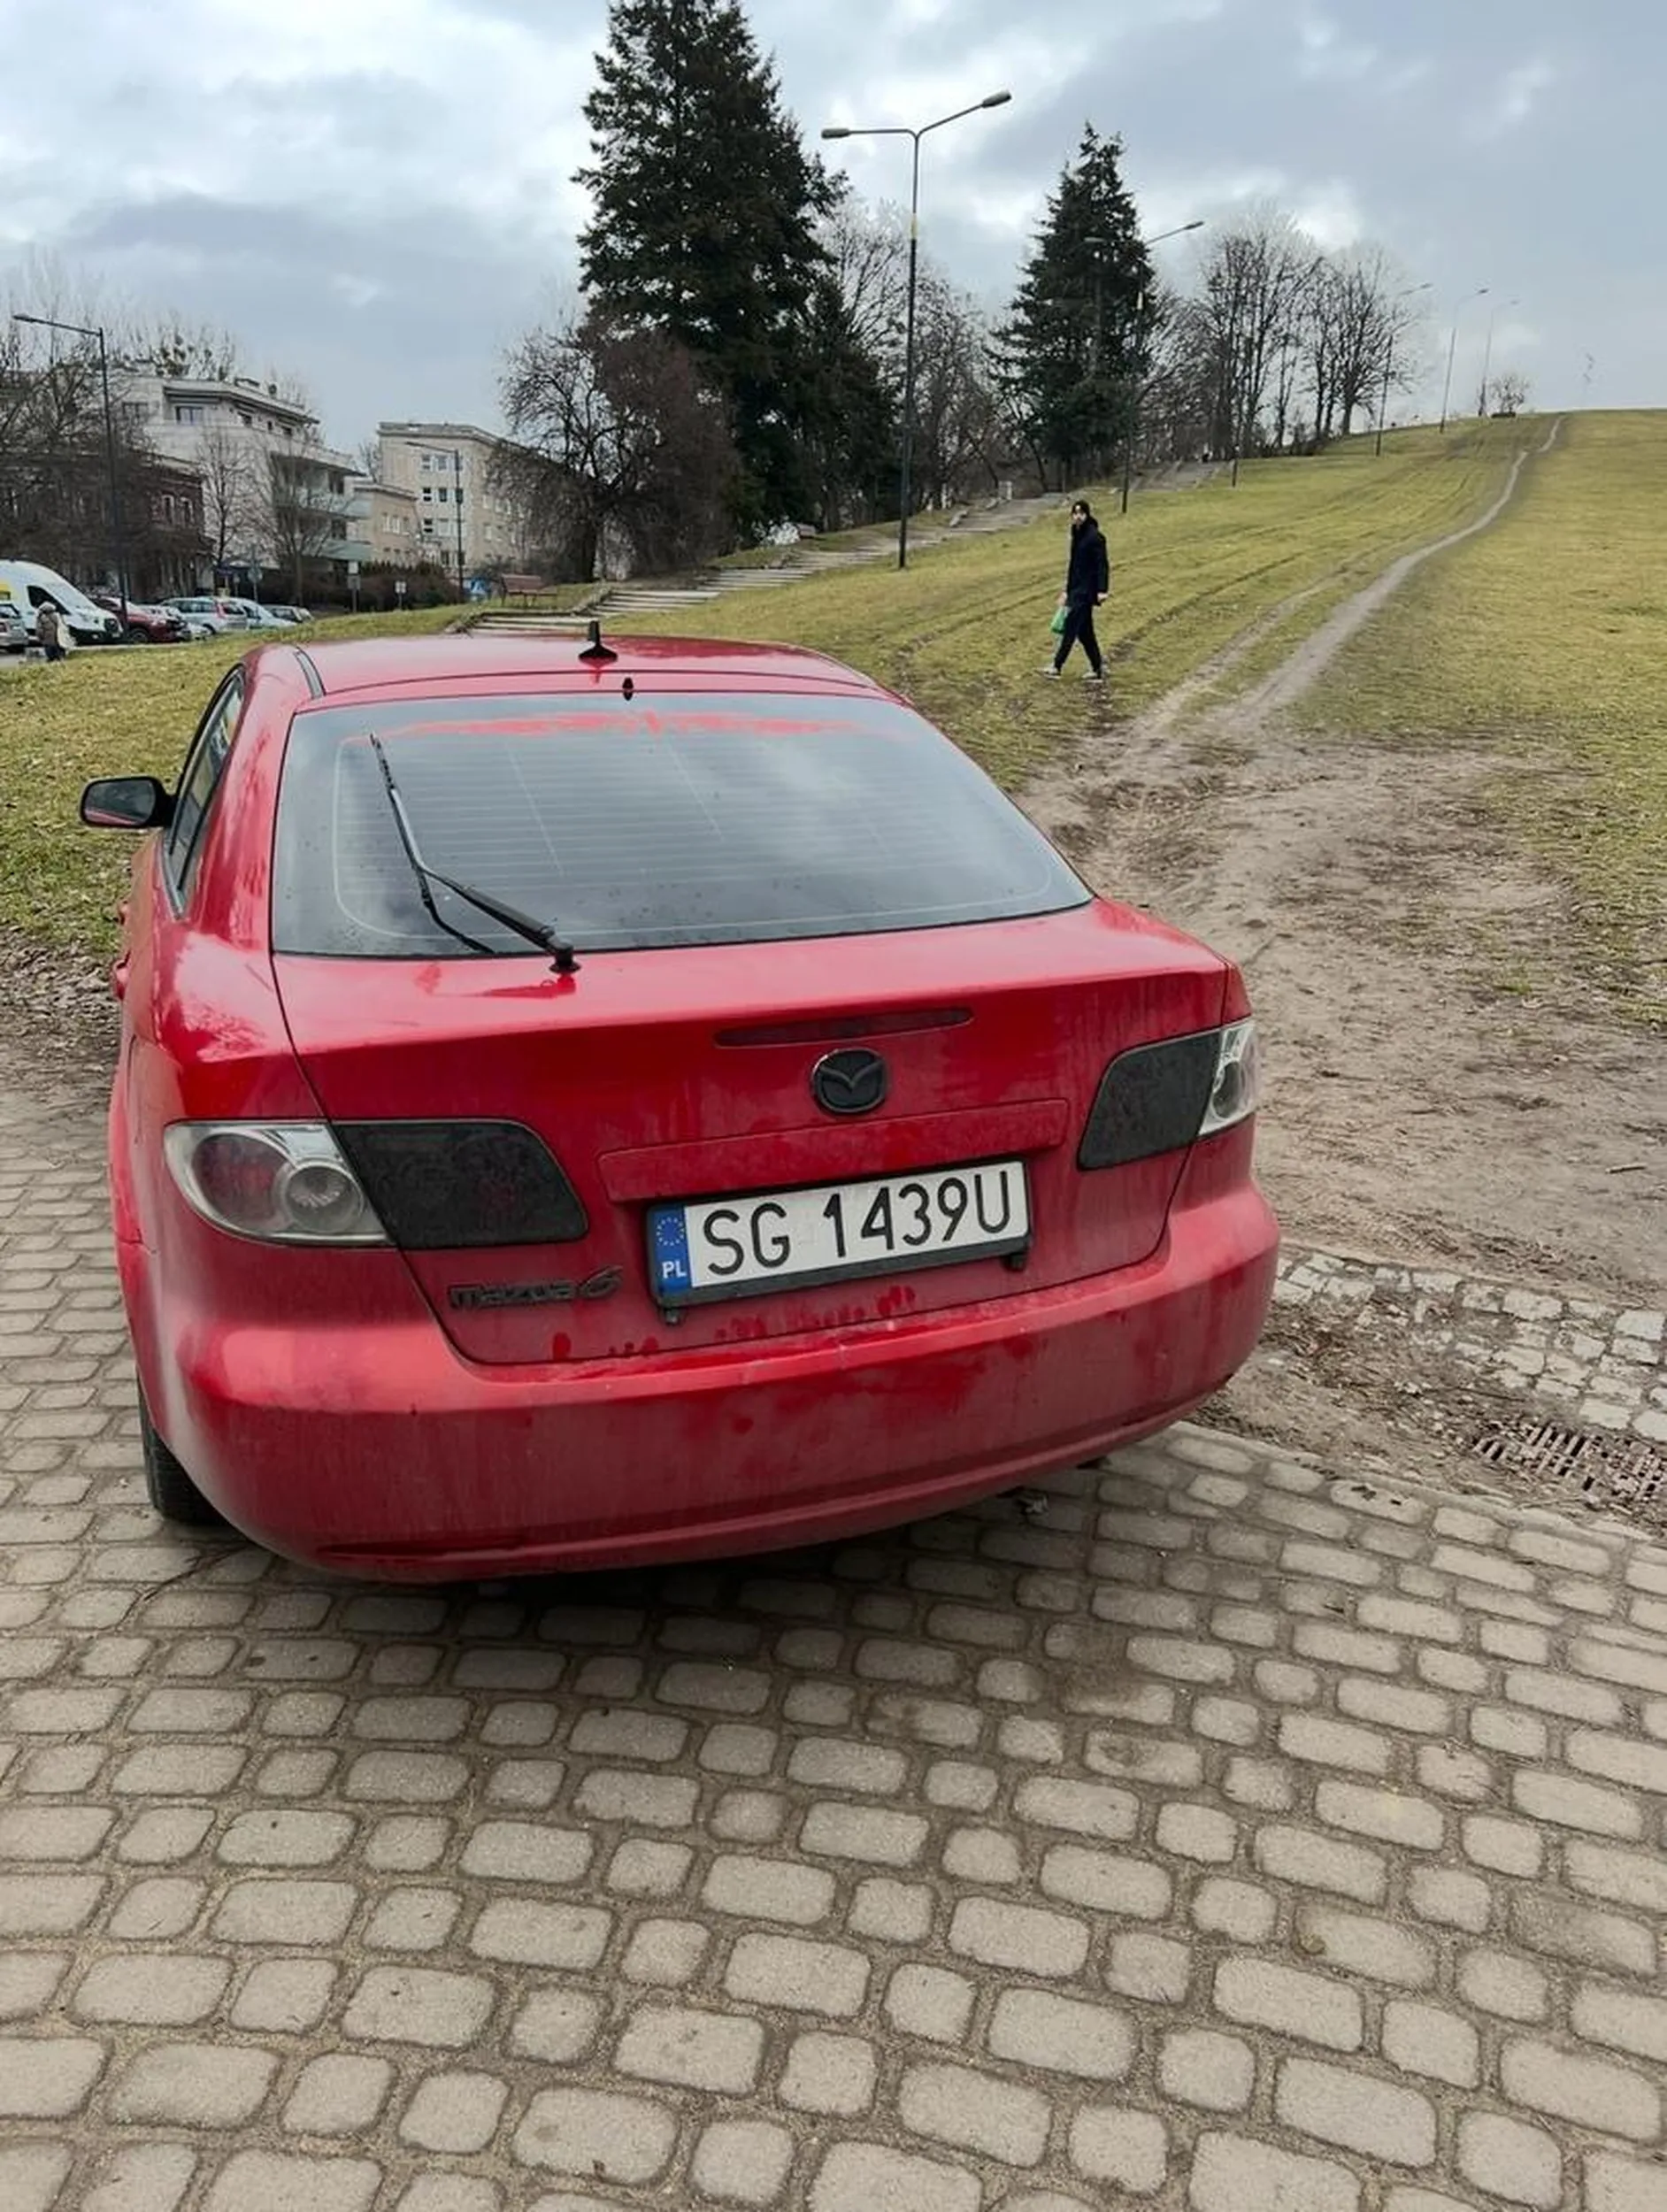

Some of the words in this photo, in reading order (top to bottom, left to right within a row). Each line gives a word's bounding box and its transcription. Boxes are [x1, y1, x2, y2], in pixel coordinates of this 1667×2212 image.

[703, 1202, 790, 1275] SG
[823, 1171, 1010, 1257] 1439U
[662, 1261, 687, 1279] PL
